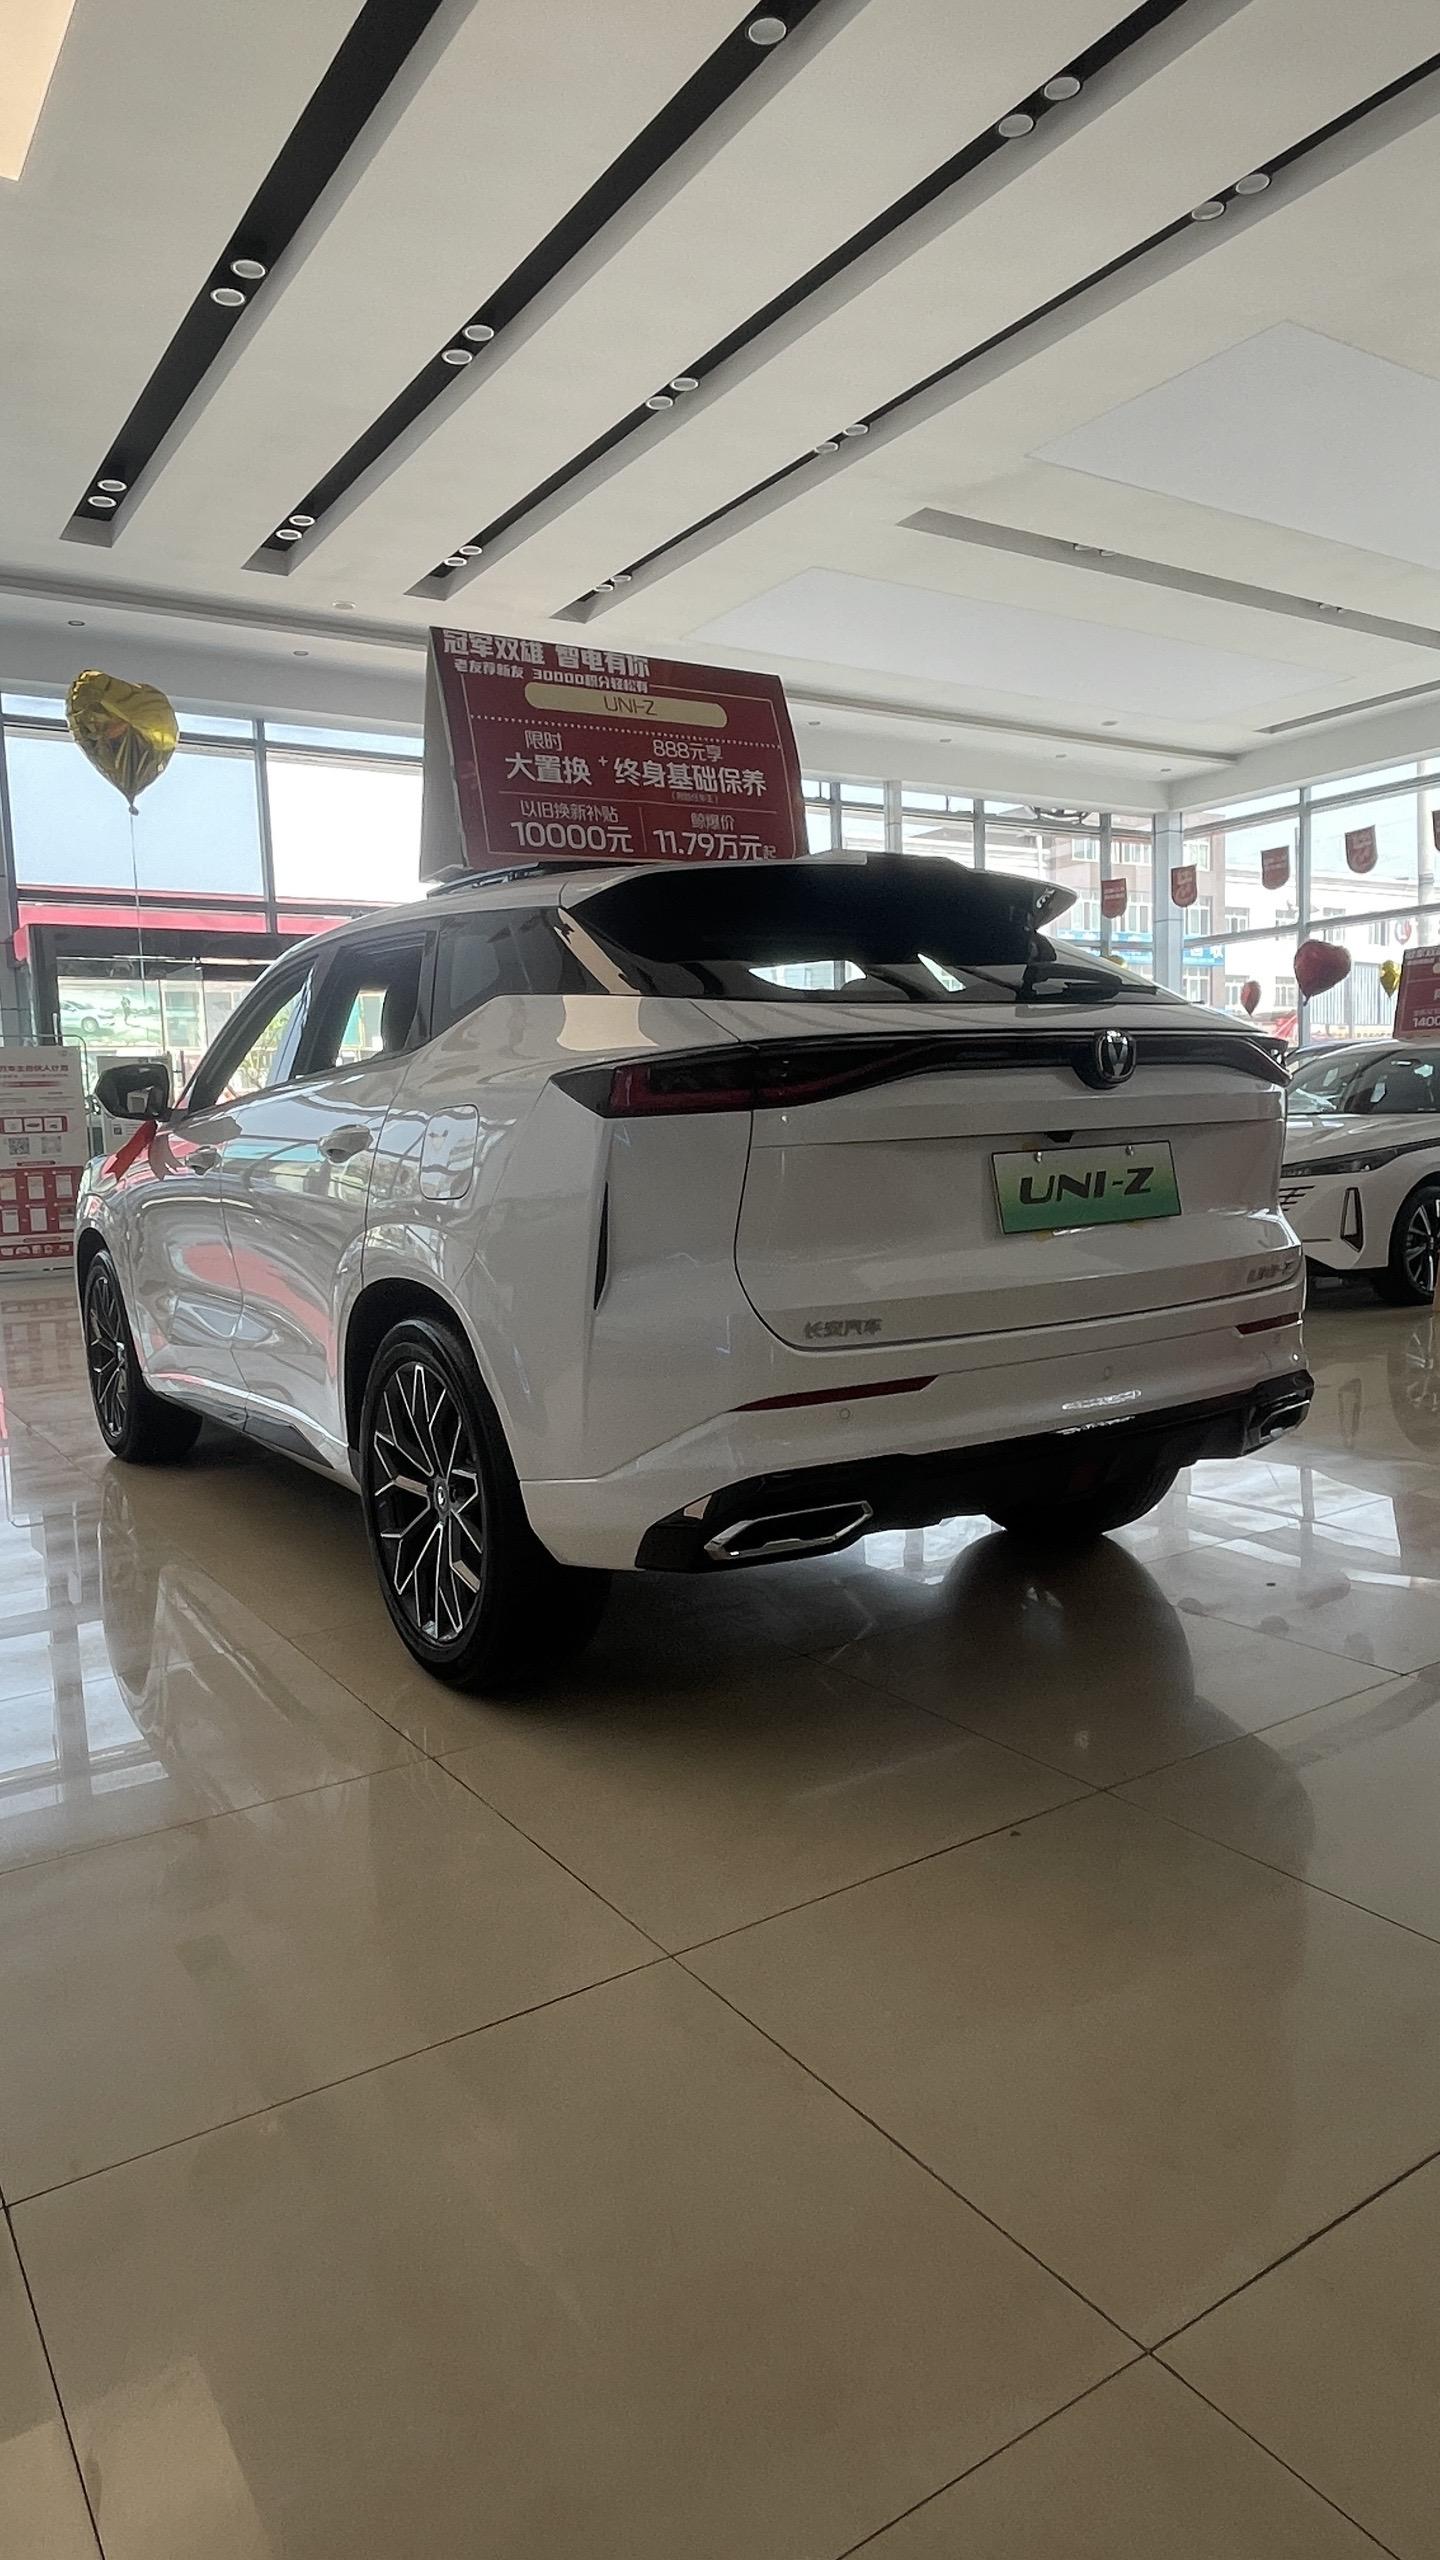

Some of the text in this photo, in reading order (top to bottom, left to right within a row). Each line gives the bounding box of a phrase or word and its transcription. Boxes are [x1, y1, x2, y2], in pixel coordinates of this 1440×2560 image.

[443, 629, 651, 678] 冠军双雄 智电有你
[604, 694, 658, 716] UNI-Z
[524, 729, 562, 752] 限时
[652, 738, 723, 763] 888元享
[505, 751, 593, 786] 大置换
[613, 757, 767, 797] 终身基础保养
[520, 799, 619, 823] 以旧换新补贴
[510, 821, 634, 853] 10000元
[653, 828, 777, 861] 11.79万元起
[1018, 1166, 1156, 1205] UNI-Z
[803, 1318, 882, 1340] 长安汽车
